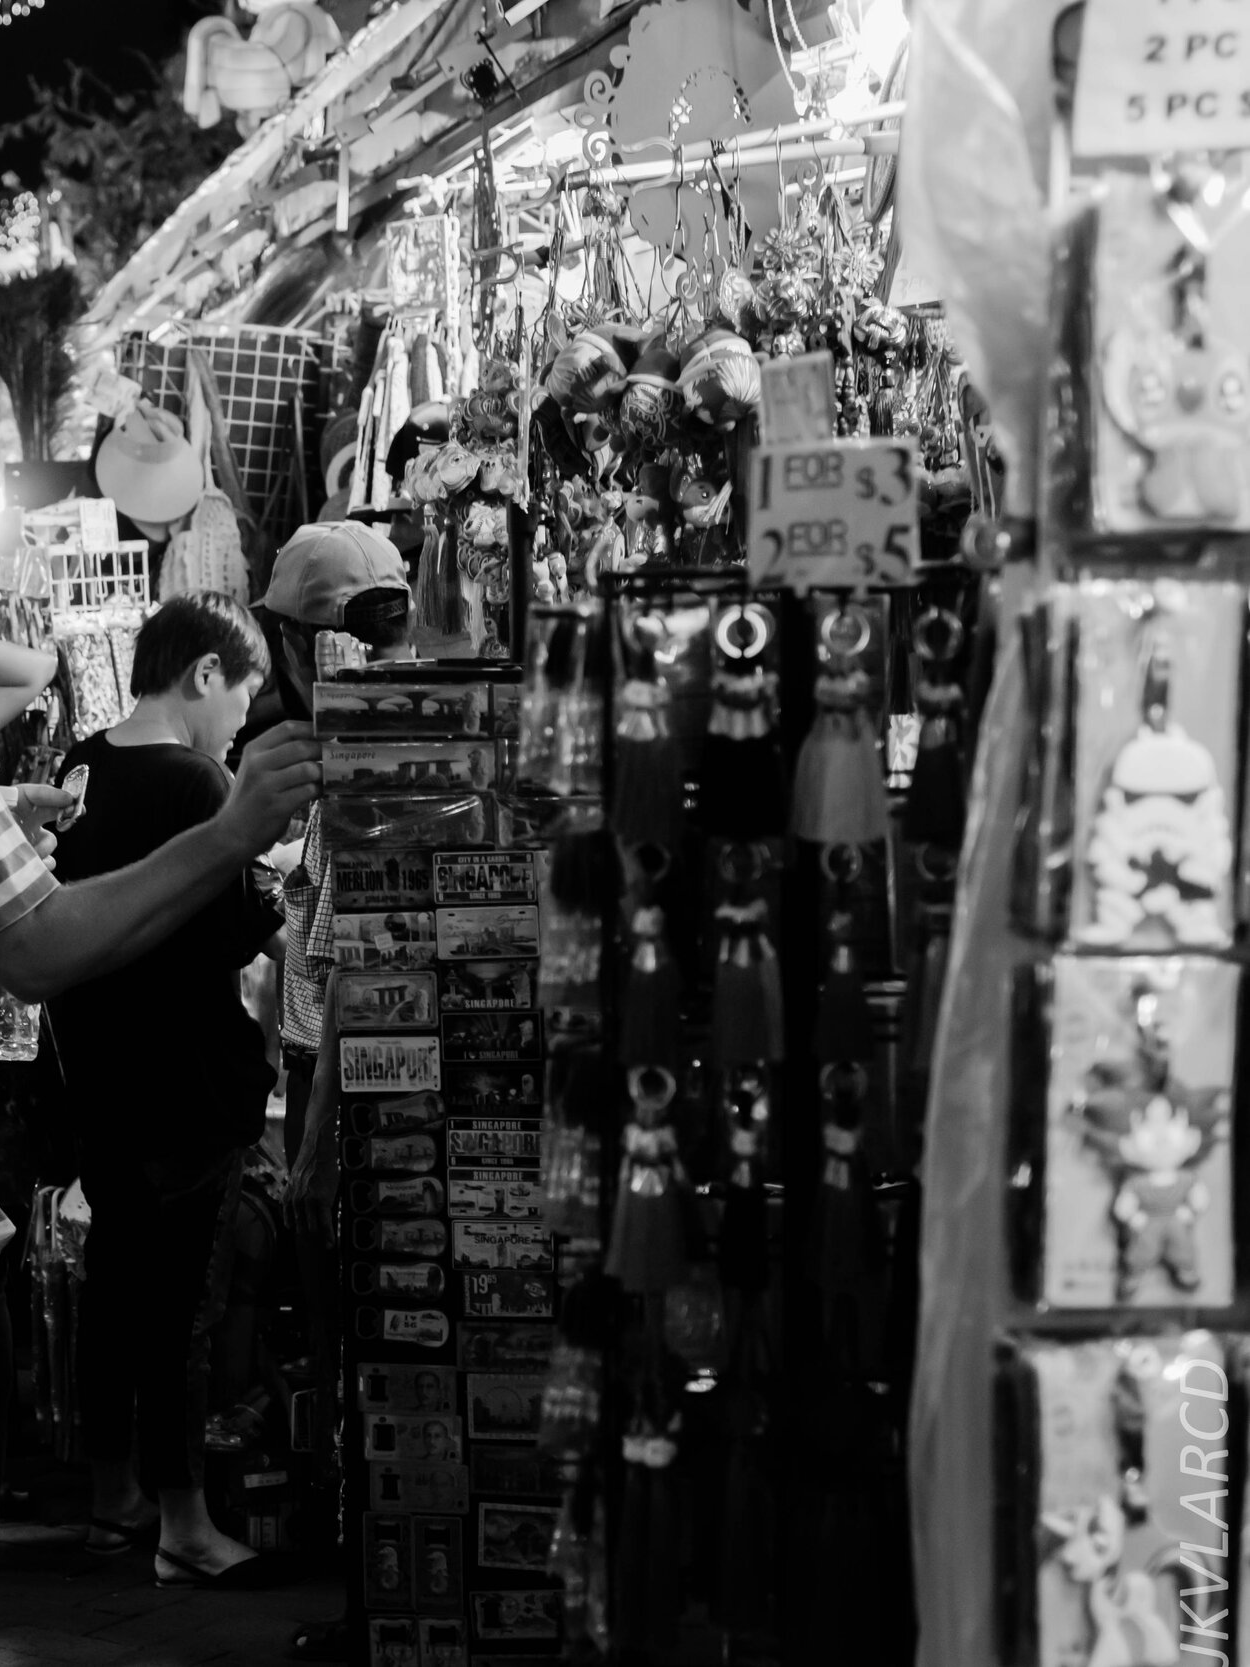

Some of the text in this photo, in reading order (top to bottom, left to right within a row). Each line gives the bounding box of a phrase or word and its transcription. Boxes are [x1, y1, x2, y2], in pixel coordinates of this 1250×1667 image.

[1144, 30, 1237, 62] 2 PC
[1127, 92, 1146, 121] 5
[1165, 90, 1218, 118] PC
[757, 455, 772, 511] 1
[784, 453, 845, 489] FOR
[759, 529, 786, 584] 2
[787, 519, 848, 555] FOR
[330, 751, 376, 761] Singapore
[336, 869, 430, 891] MERLION 1965
[437, 865, 533, 891] SINGAPORE
[464, 999, 515, 1009] SINGAPORE
[344, 1046, 437, 1081] SINGAPORE
[479, 1050, 518, 1059] SINGAPORE
[472, 1120, 521, 1130] SINGAPORE
[473, 1171, 524, 1181] SINGAPORE
[474, 1236, 531, 1245] SINGAPORE
